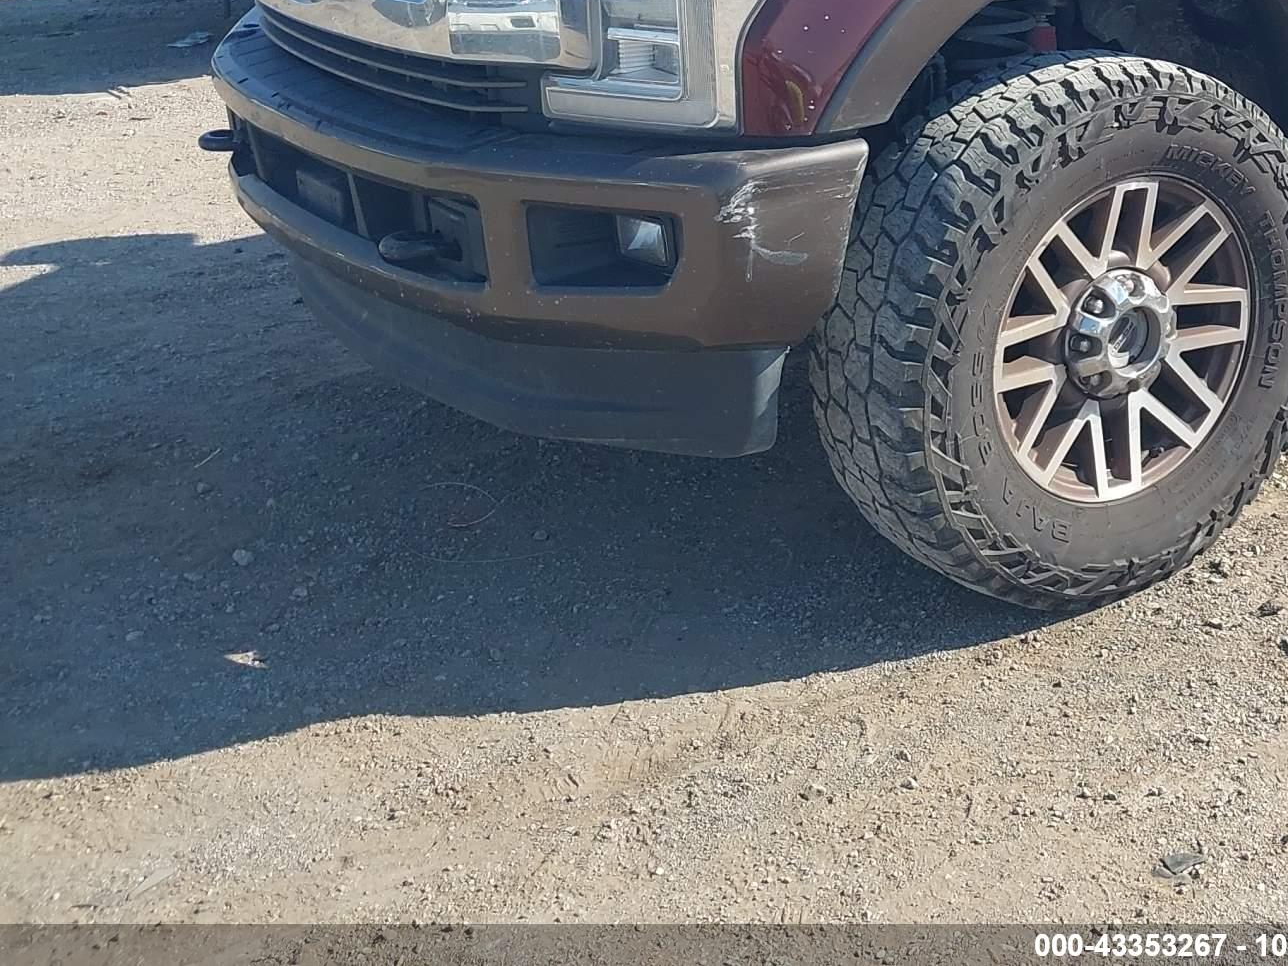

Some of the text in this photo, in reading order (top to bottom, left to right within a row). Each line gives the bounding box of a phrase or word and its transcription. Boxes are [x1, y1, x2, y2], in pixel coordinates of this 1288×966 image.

[1165, 143, 1288, 390] MICKEY THOMPSON
[970, 351, 993, 466] BOSS
[1002, 476, 1071, 544] BAJA
